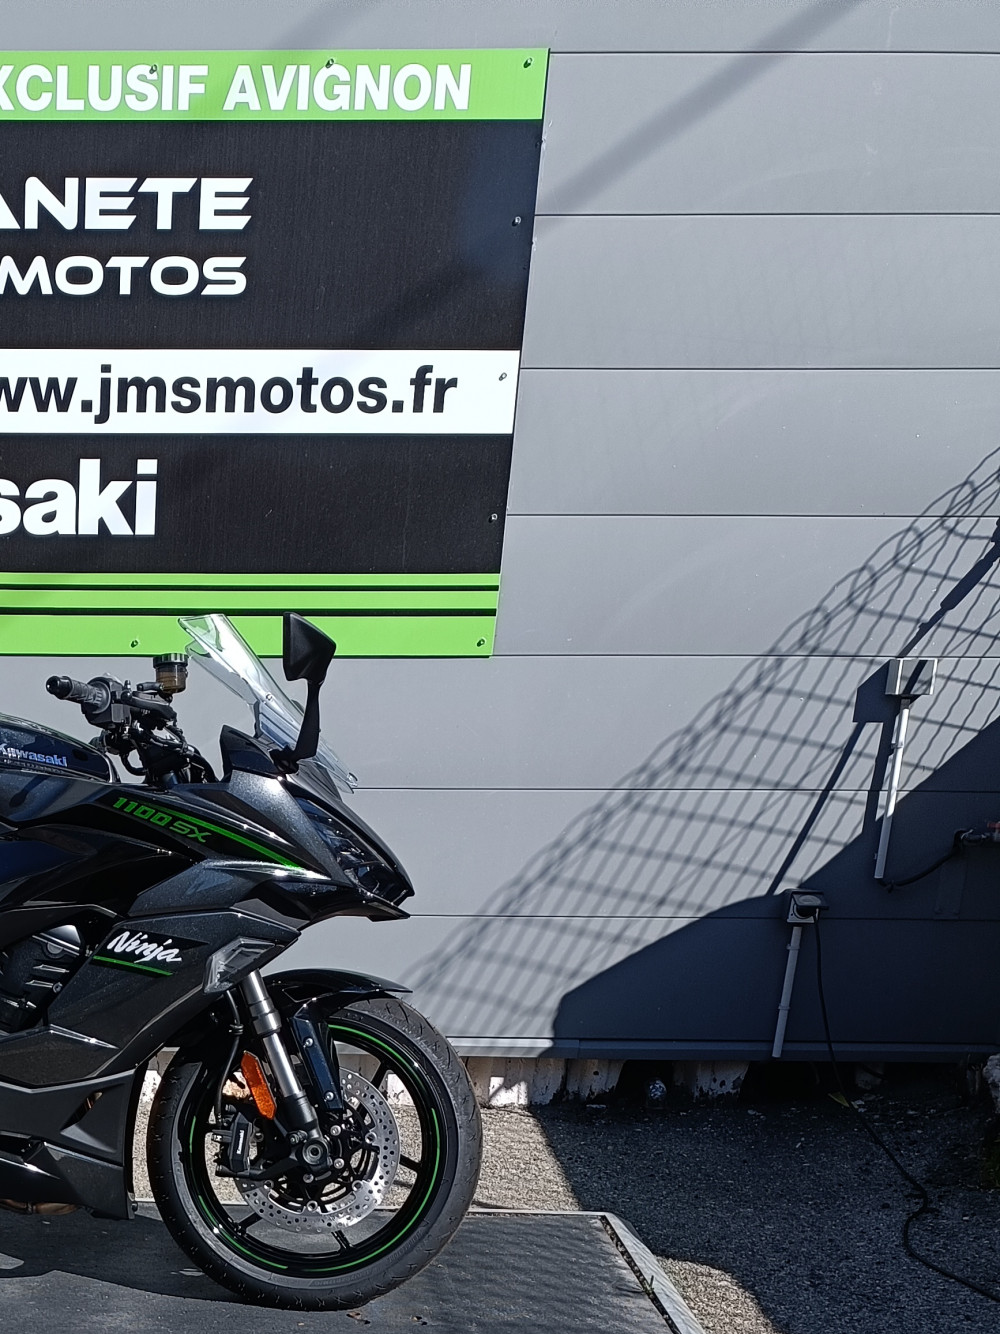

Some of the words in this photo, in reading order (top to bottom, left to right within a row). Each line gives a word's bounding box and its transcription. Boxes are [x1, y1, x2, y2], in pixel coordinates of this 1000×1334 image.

[222, 63, 472, 112] AVIGNON
[113, 797, 172, 827] 1100
[169, 820, 212, 843] SX
[106, 931, 182, 964] Ninja
